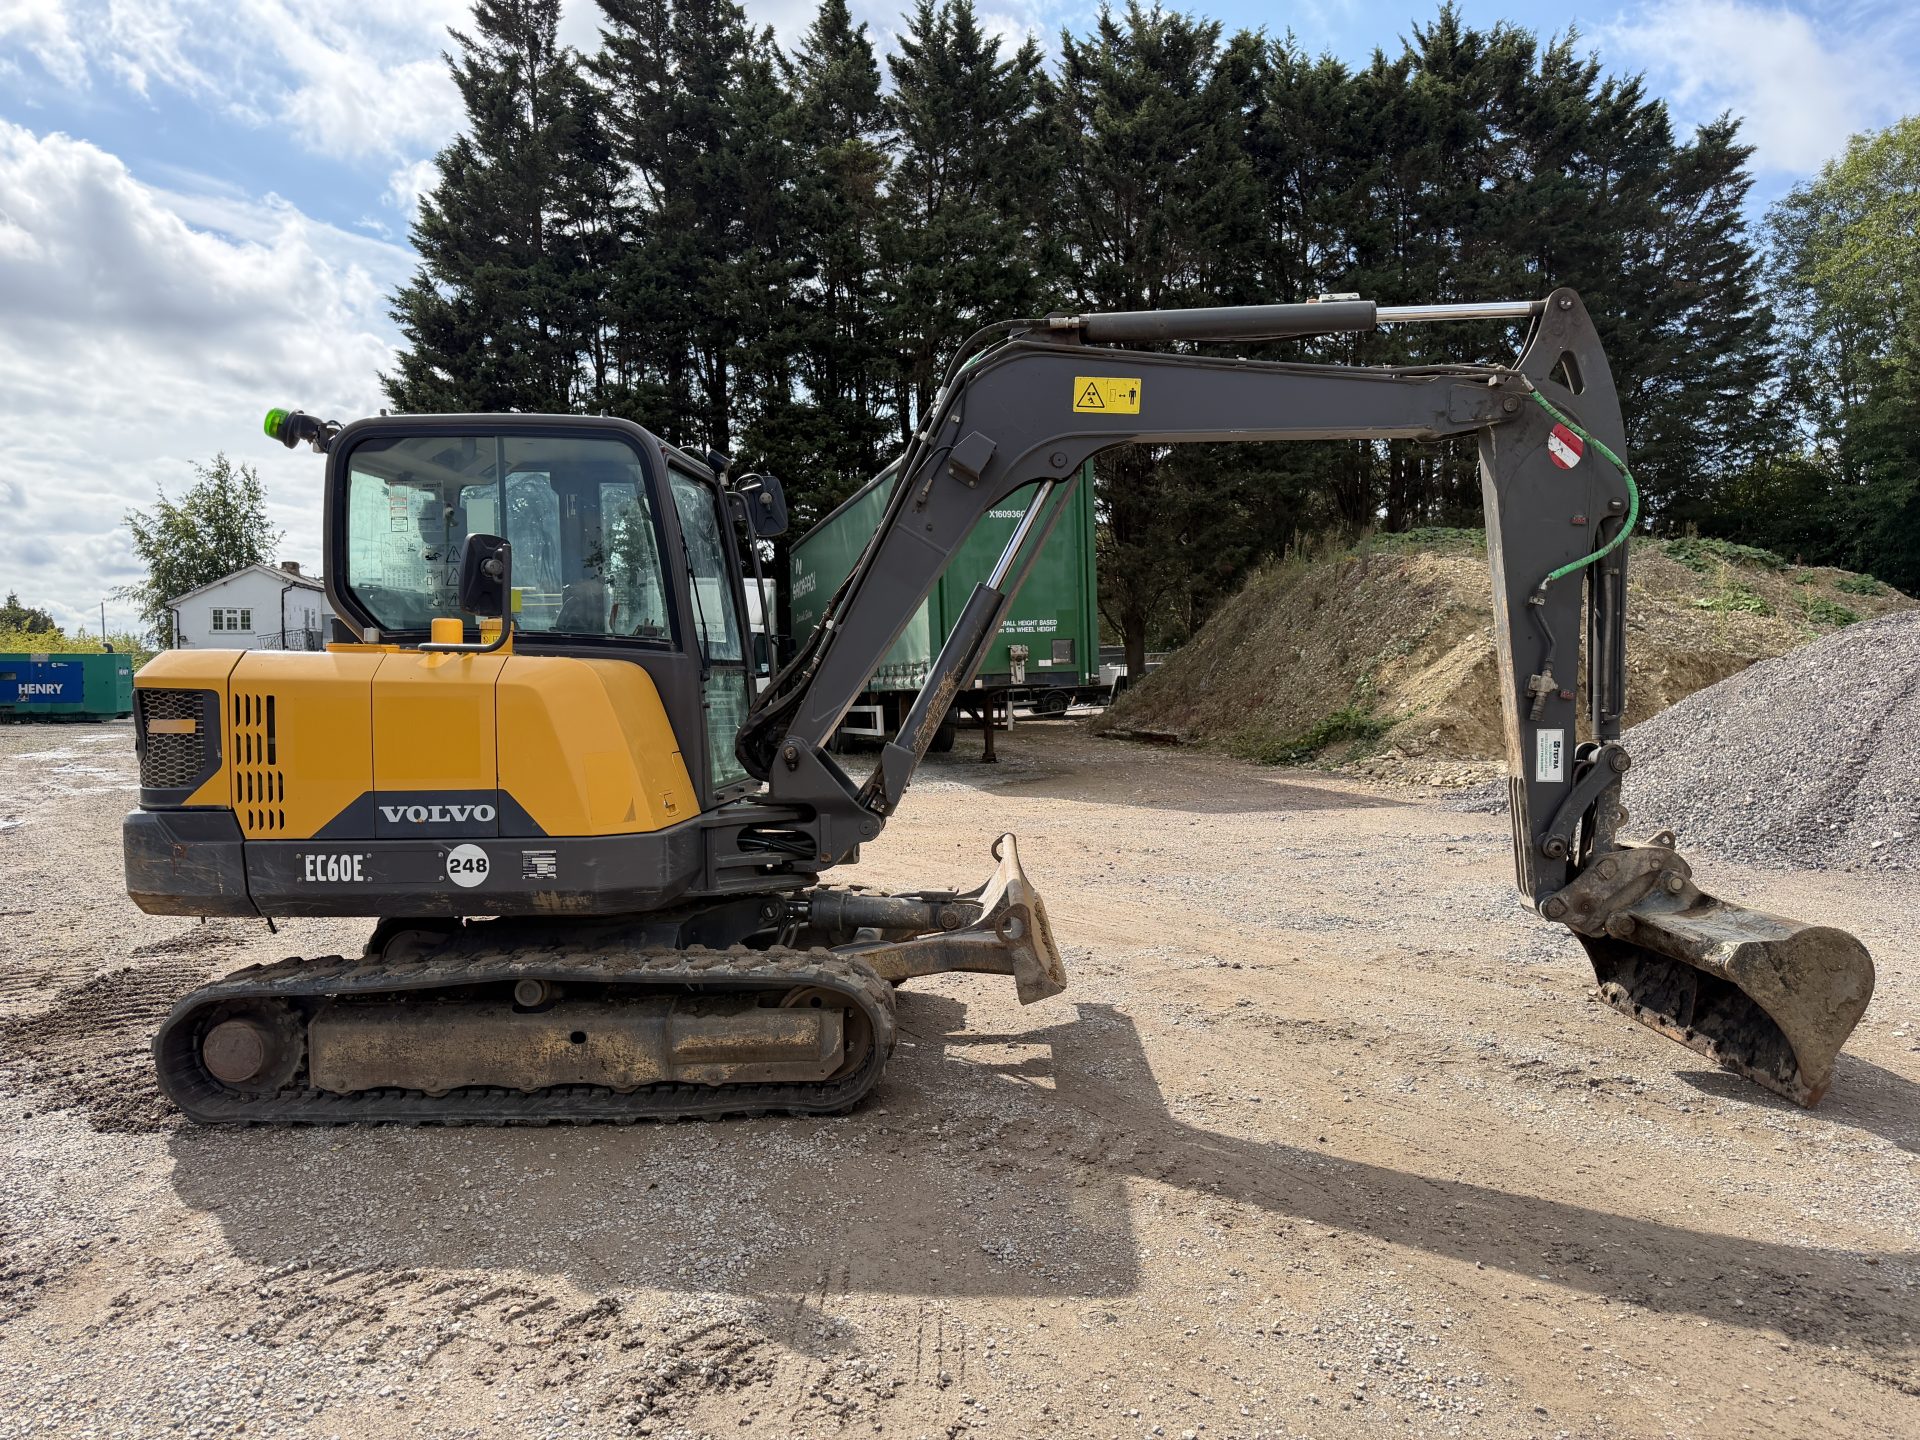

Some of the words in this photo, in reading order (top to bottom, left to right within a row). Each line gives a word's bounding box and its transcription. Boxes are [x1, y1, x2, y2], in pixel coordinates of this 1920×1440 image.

[18, 684, 63, 694] HENRY
[379, 805, 496, 823] VOLVO
[305, 855, 364, 882] EC60E
[450, 858, 487, 873] 248
